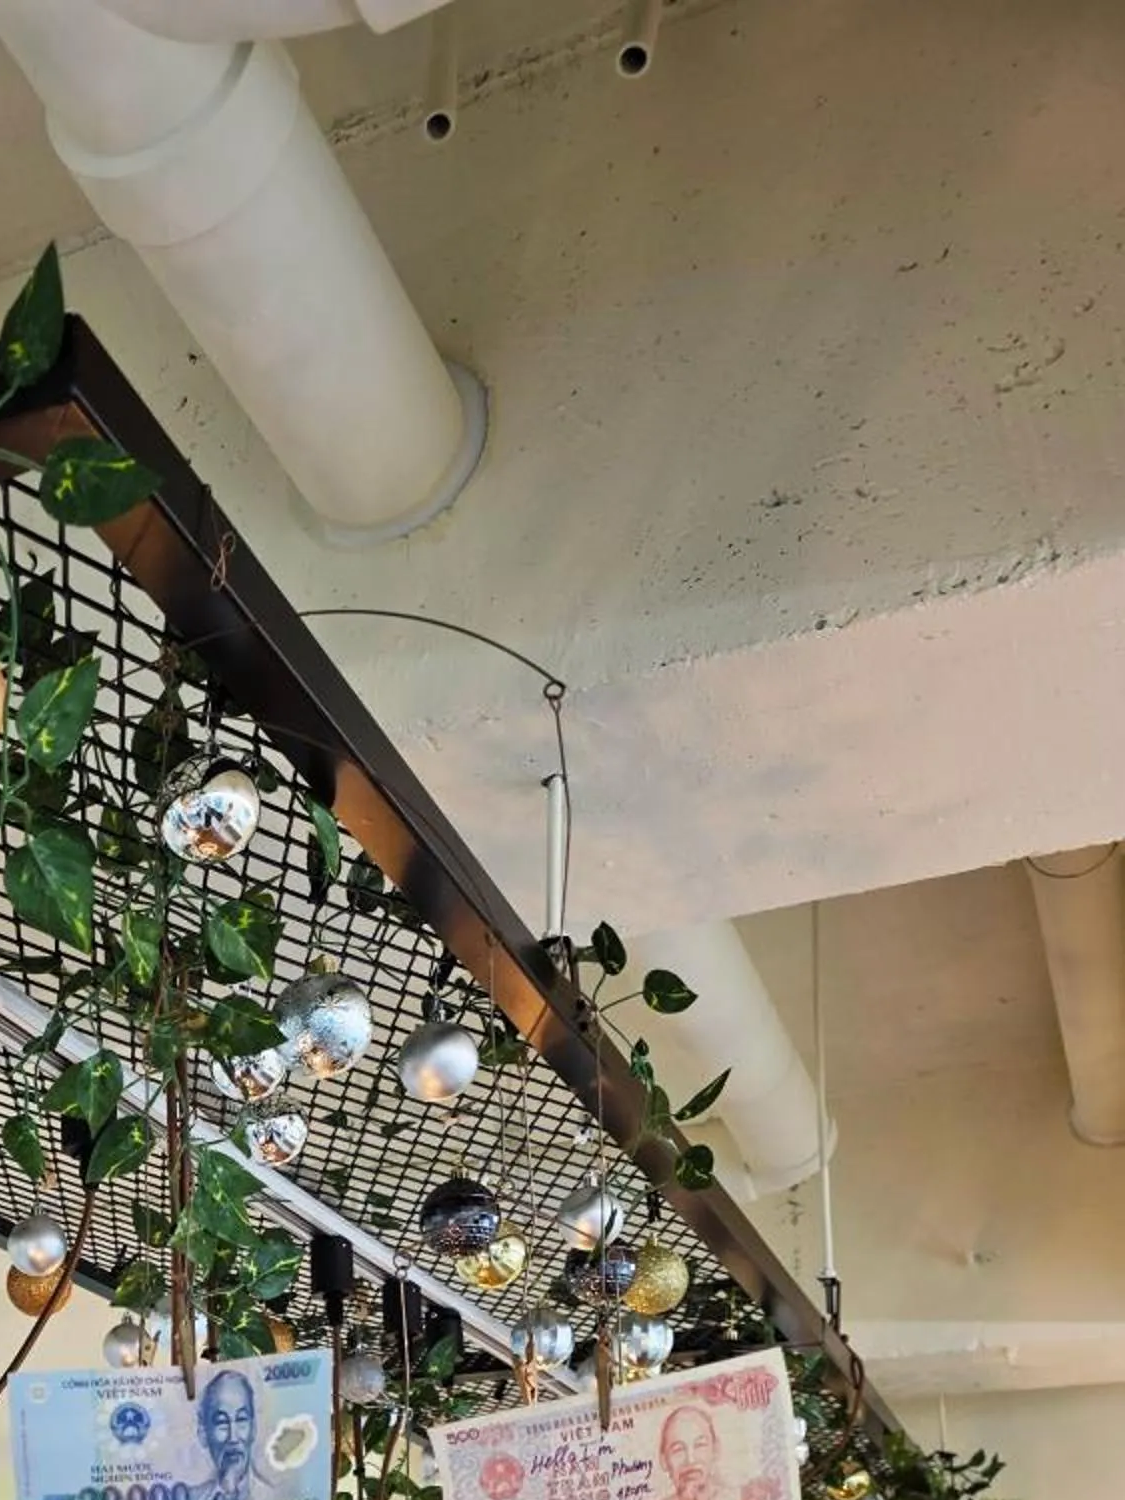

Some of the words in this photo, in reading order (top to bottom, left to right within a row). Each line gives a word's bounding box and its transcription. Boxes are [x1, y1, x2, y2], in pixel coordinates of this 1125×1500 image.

[263, 1360, 311, 1383] 20000
[446, 1427, 480, 1445] 500
[531, 1444, 577, 1474] Hello
